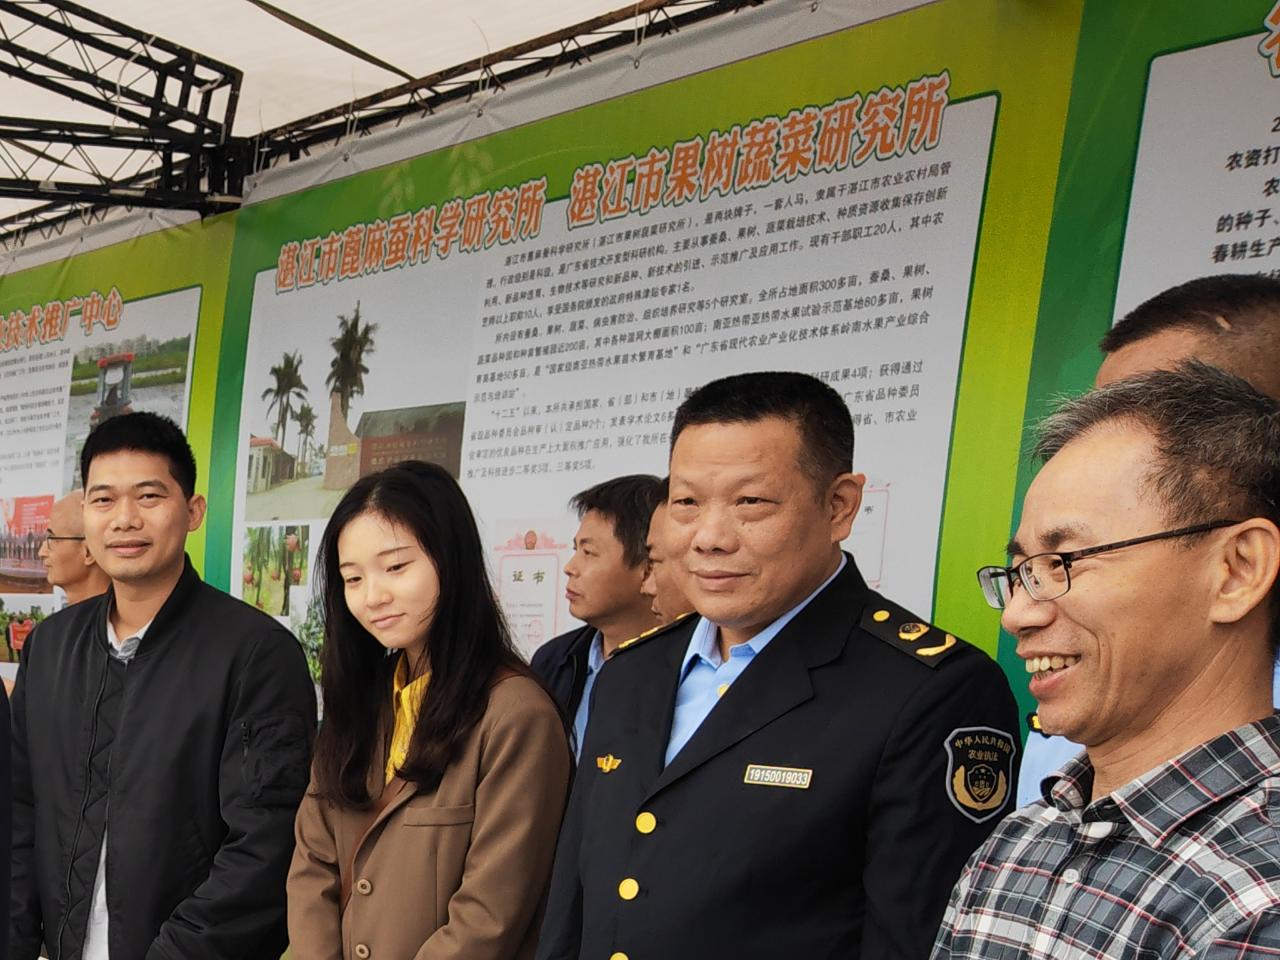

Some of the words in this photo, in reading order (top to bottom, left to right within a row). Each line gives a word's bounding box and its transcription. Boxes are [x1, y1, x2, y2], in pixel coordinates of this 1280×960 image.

[275, 180, 548, 293] 湛江市蓖麻蚕科学研究所
[569, 72, 950, 224] 湛江市果树蔬菜研究所
[750, 768, 808, 785] 19150019033
